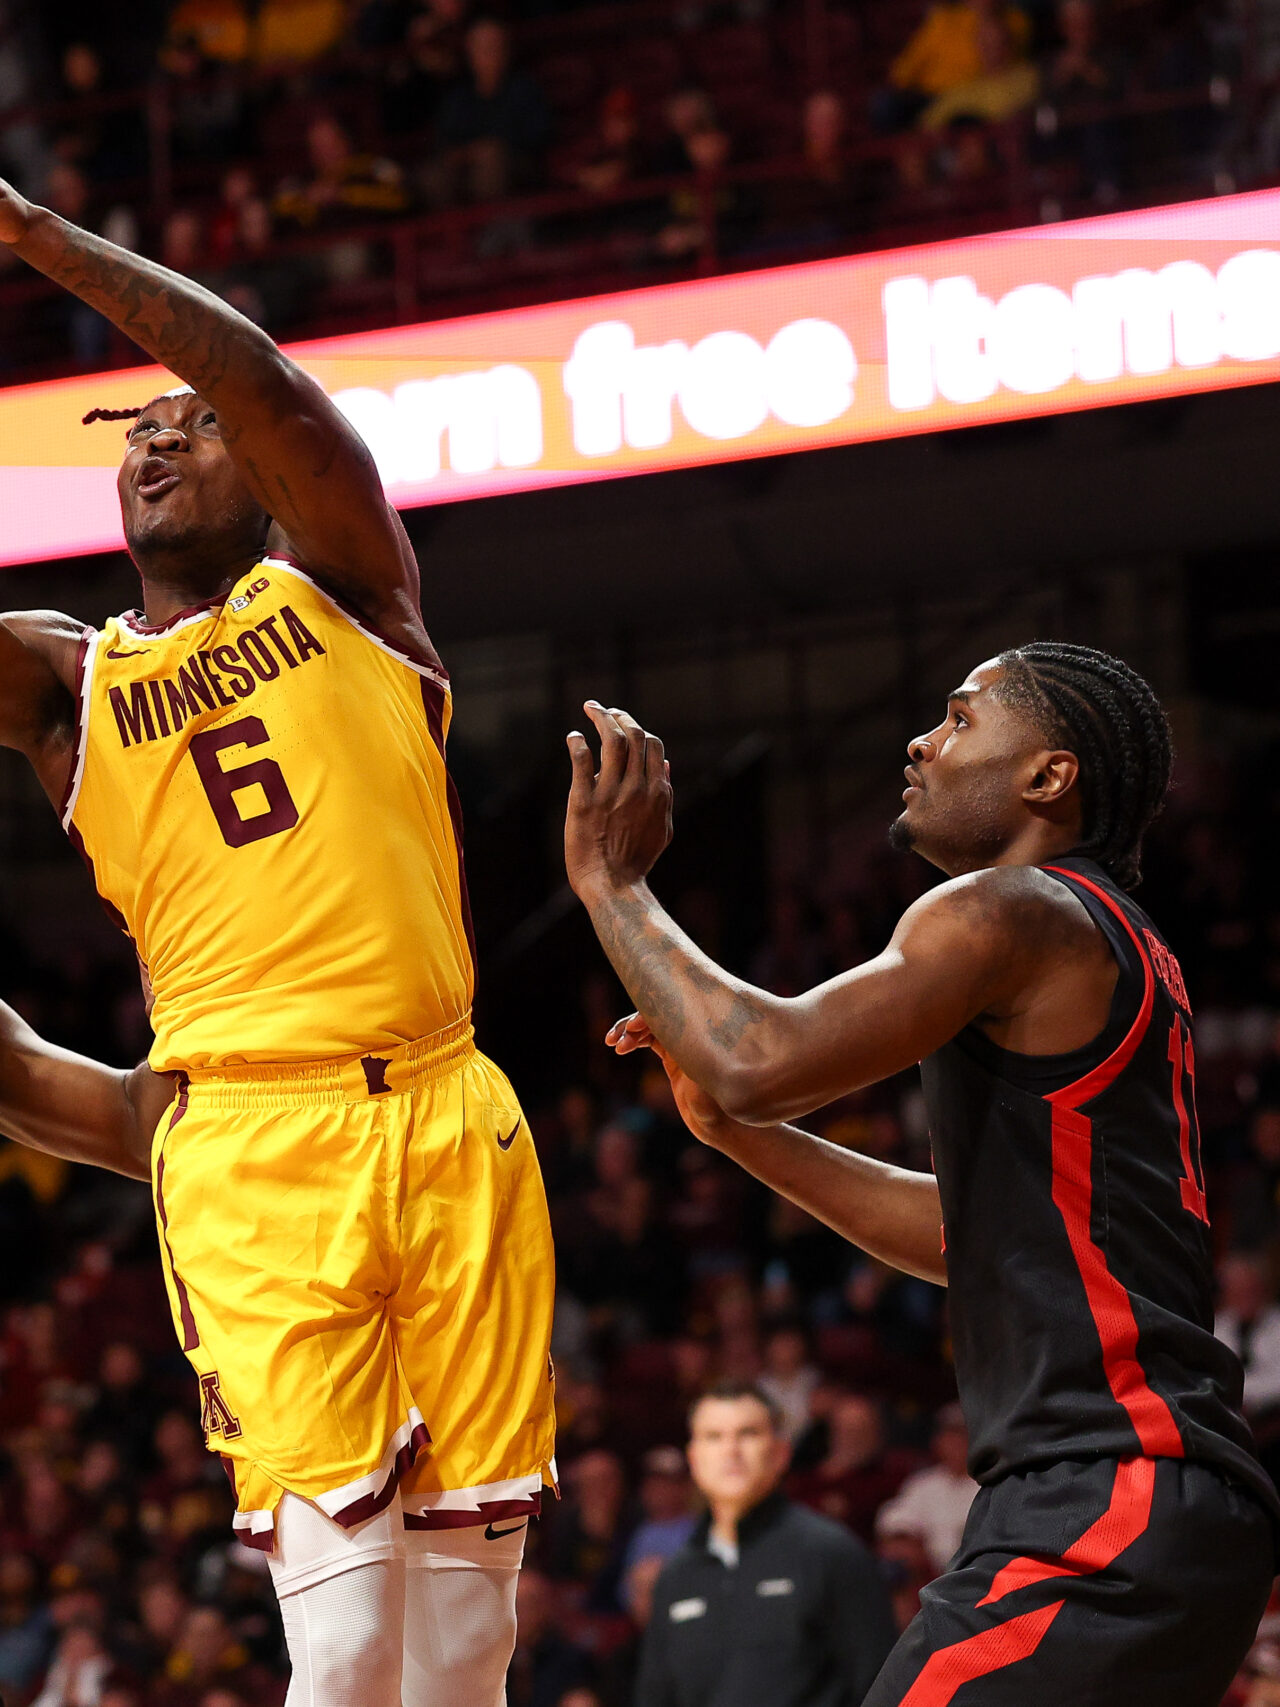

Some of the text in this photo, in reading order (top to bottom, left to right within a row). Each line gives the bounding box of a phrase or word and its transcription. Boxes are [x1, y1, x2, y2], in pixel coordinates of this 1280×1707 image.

[338, 366, 542, 486] arn
[564, 319, 857, 455] free
[108, 605, 326, 748] MINNESOTA
[189, 715, 300, 849] 6
